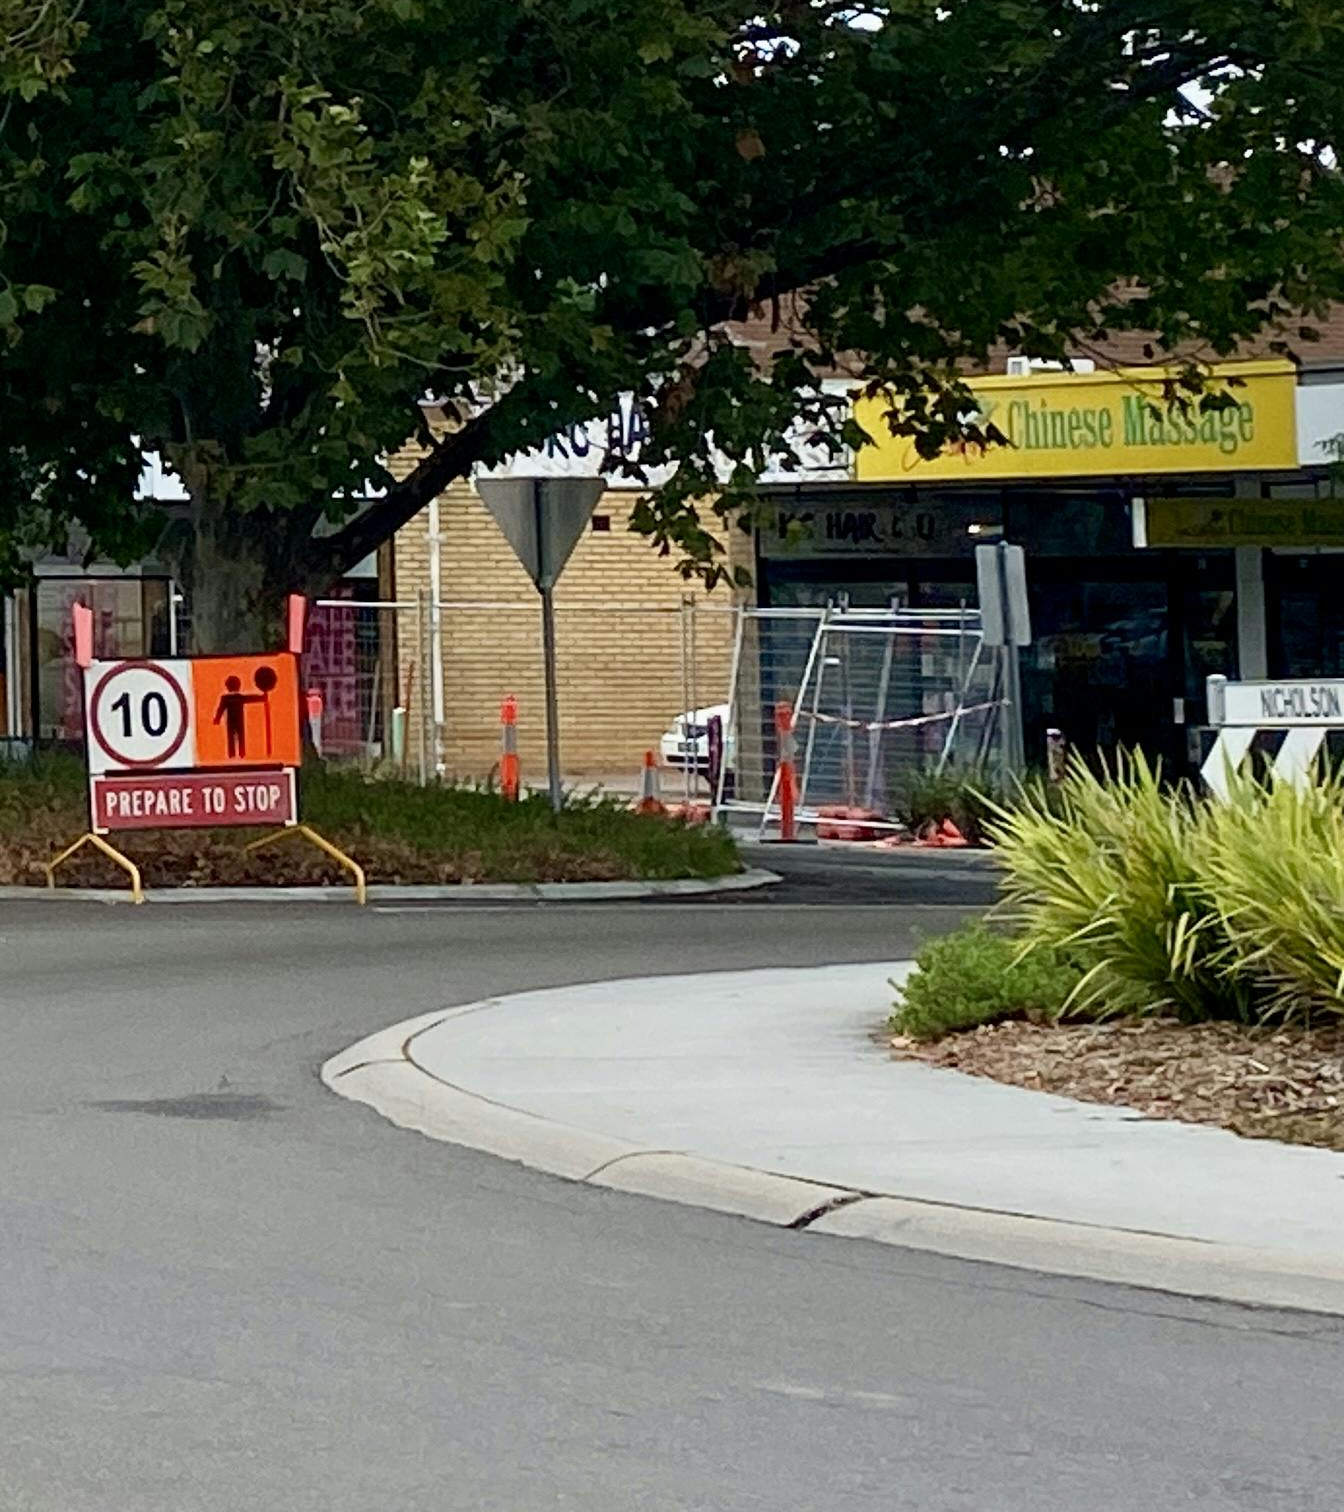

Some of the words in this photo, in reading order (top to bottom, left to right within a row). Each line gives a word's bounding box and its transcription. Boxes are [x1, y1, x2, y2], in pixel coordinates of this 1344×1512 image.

[1009, 398, 1111, 450] Chinese
[110, 691, 169, 738] 10
[1260, 686, 1342, 718] NICHOLSON
[105, 788, 193, 817] PREPARE
[201, 786, 226, 813] TO
[233, 784, 281, 812] STOP
